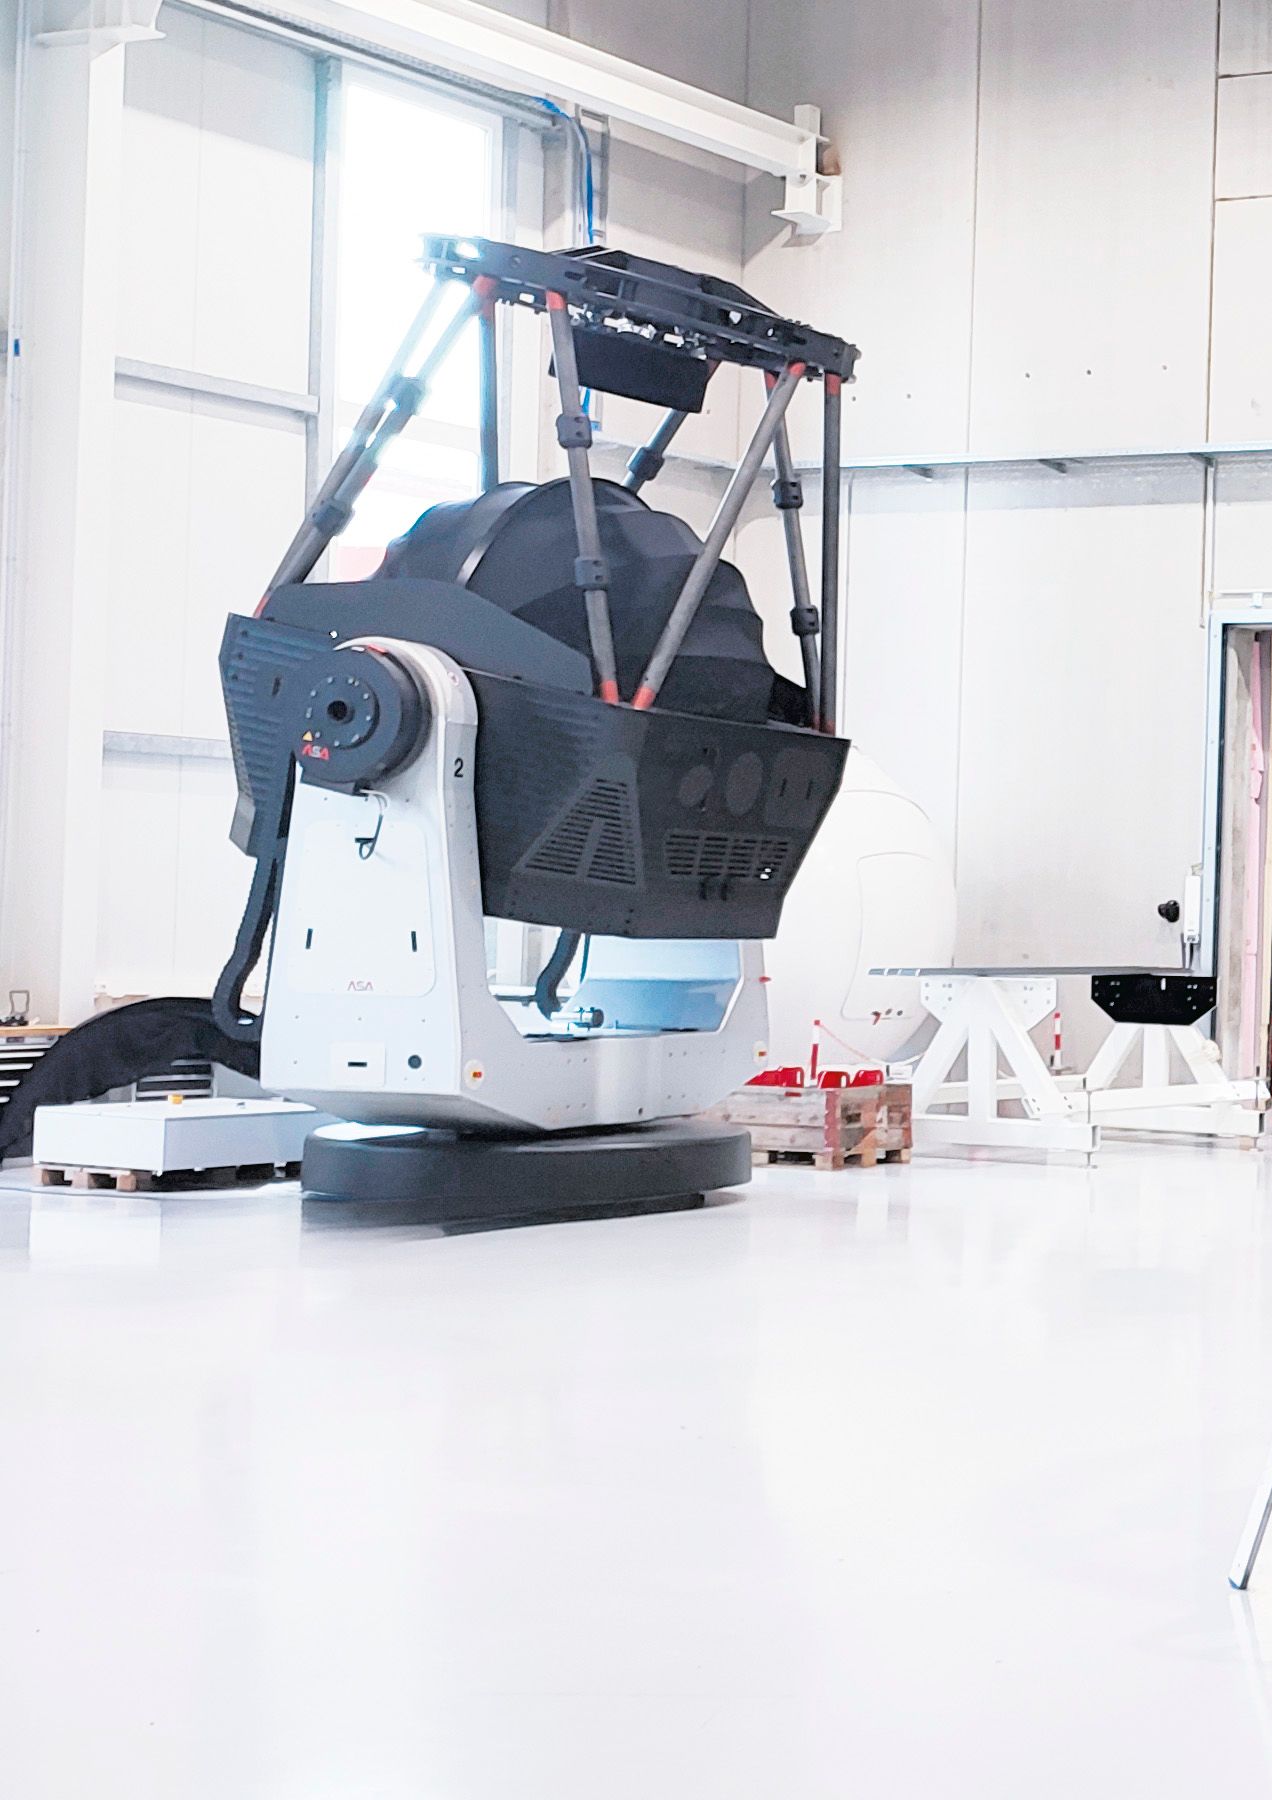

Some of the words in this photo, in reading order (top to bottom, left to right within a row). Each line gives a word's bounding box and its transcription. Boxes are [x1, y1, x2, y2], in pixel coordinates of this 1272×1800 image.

[302, 743, 330, 760] ASA
[453, 757, 464, 778] 2
[347, 980, 374, 991] ASA
